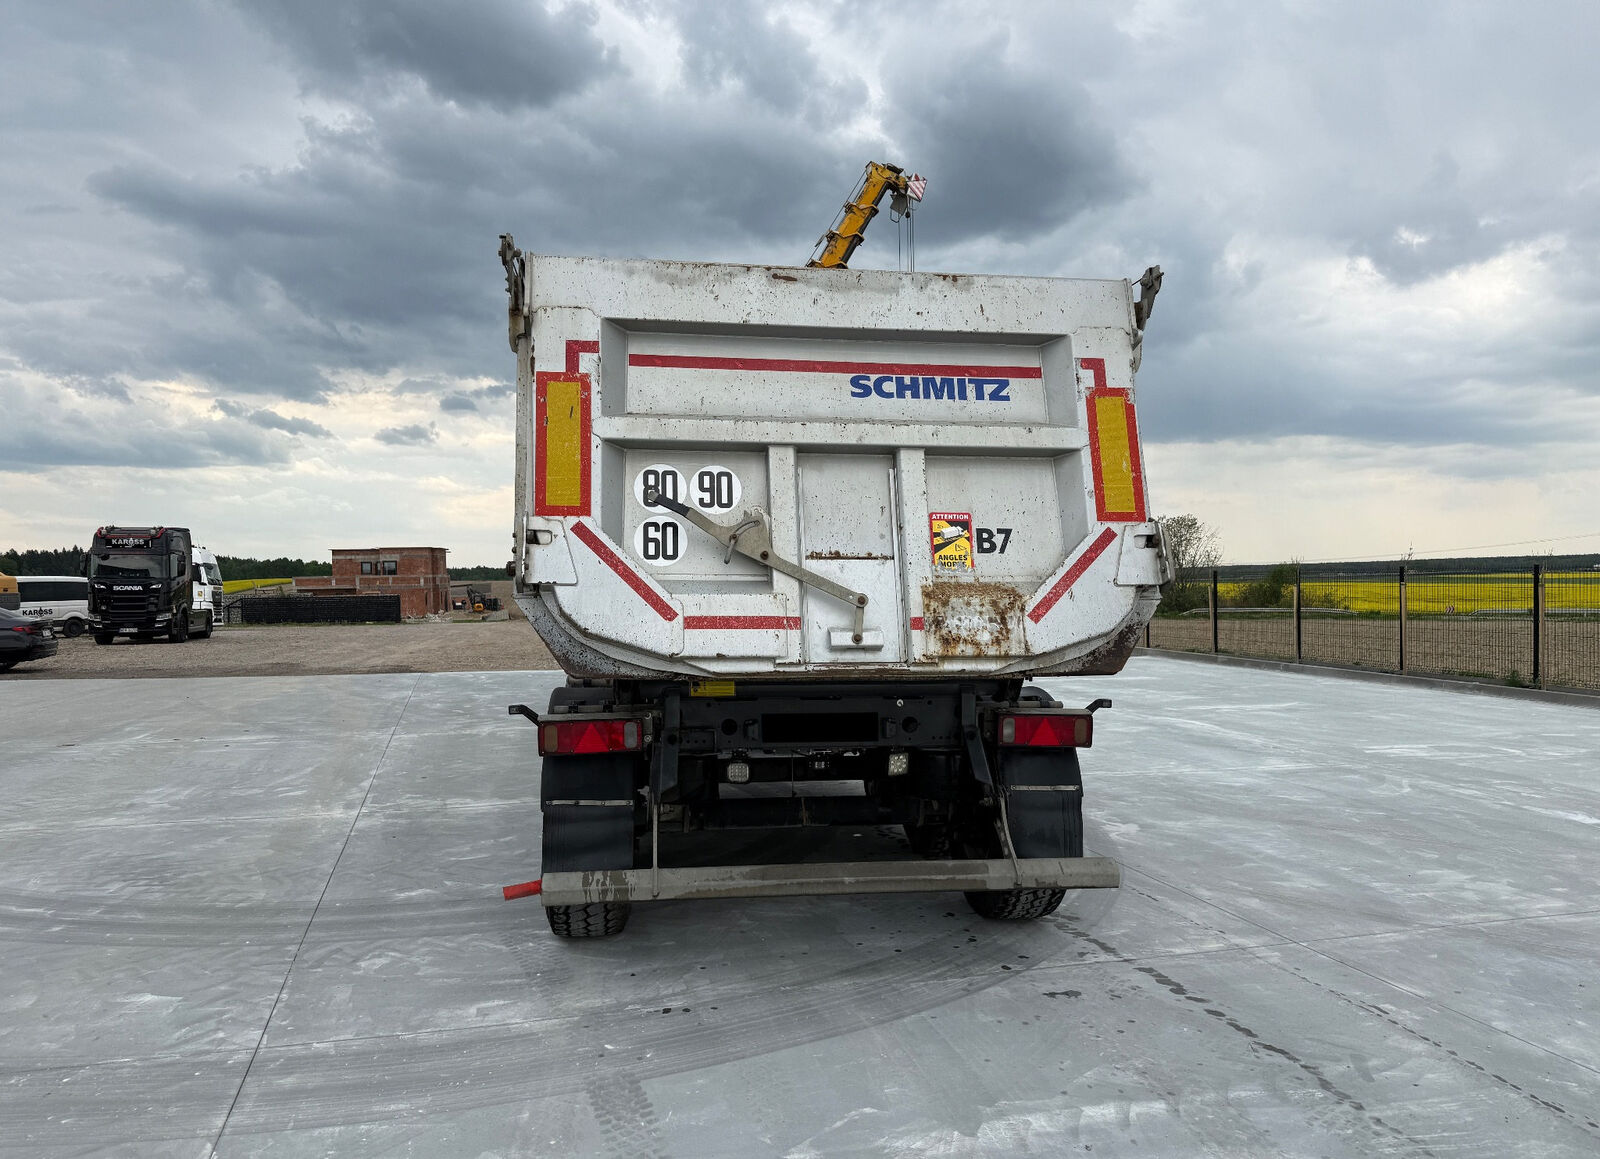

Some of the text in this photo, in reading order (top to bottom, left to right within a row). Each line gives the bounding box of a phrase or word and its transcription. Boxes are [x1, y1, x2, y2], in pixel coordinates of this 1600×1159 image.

[850, 375, 1010, 402] SCHMITZ
[643, 469, 678, 506] 80
[698, 470, 733, 508] 90
[643, 521, 679, 561] 60
[975, 527, 1013, 554] B7
[22, 608, 53, 617] KAROSS
